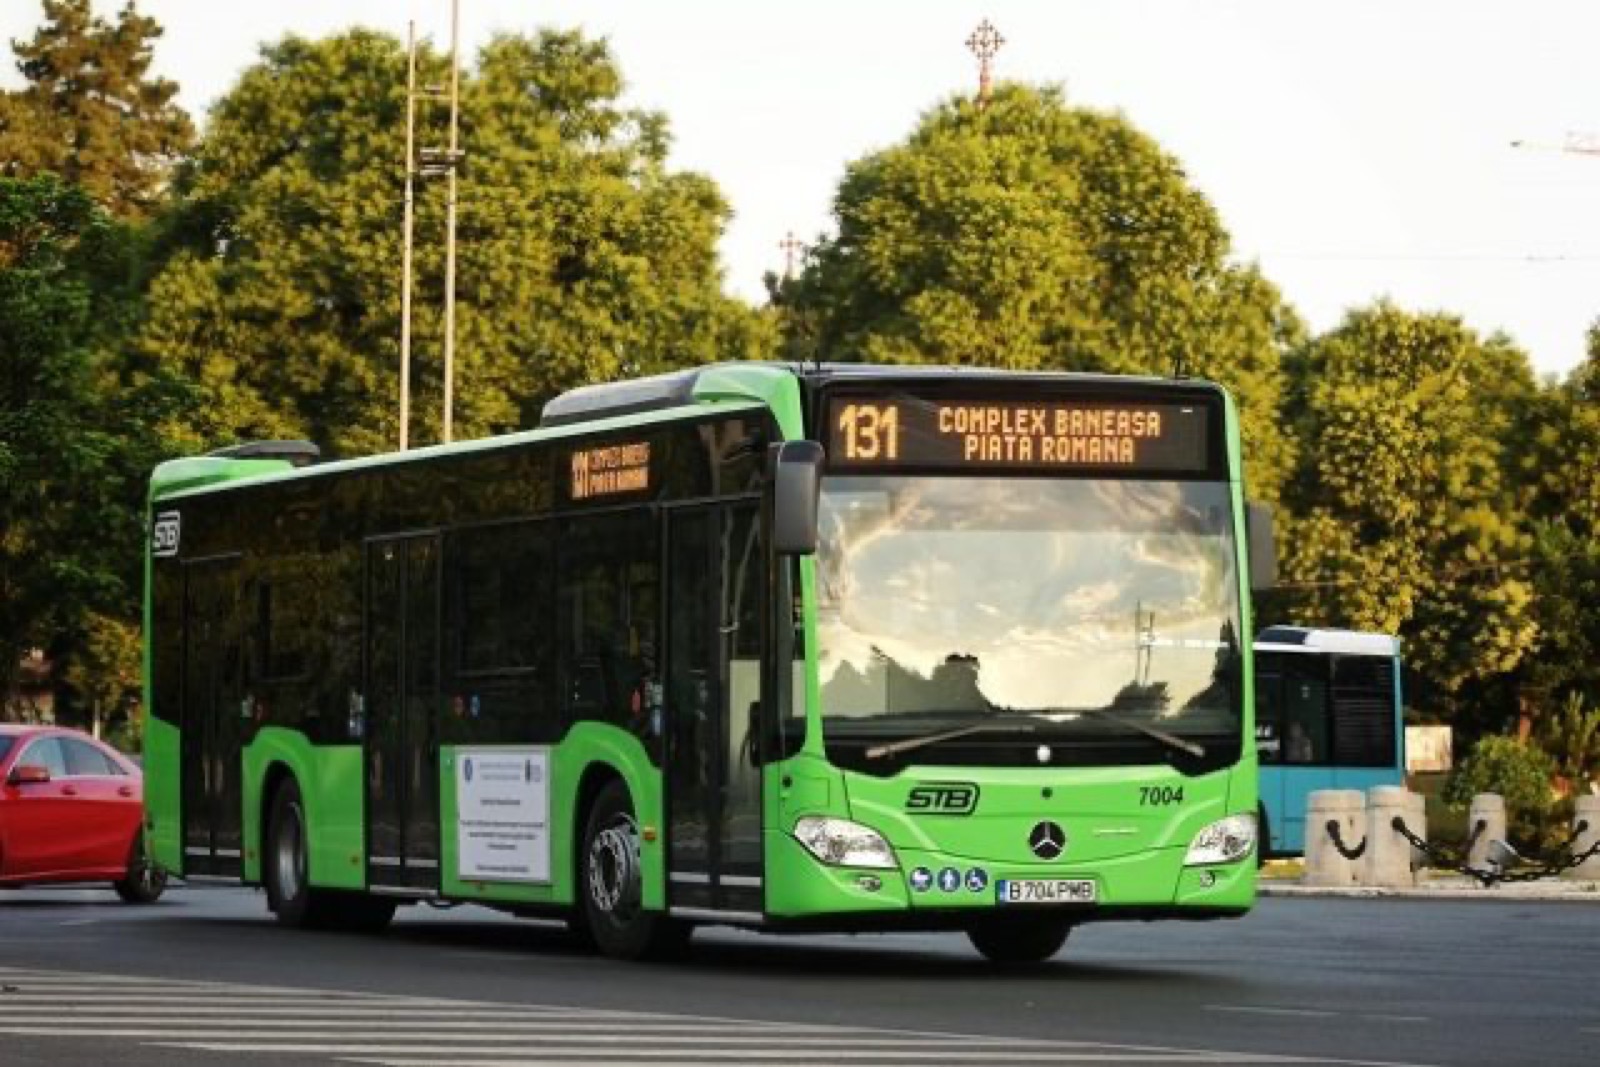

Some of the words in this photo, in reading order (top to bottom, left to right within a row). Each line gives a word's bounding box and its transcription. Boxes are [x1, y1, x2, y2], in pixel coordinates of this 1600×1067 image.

[839, 404, 898, 458] 131
[938, 406, 1046, 433] COMPLEX
[1053, 409, 1161, 437] BANEASA
[964, 434, 1033, 460] PIATA
[1041, 436, 1134, 463] ROMANA
[905, 785, 974, 810] STB
[1139, 785, 1184, 806] 7004
[1009, 881, 1021, 900] B
